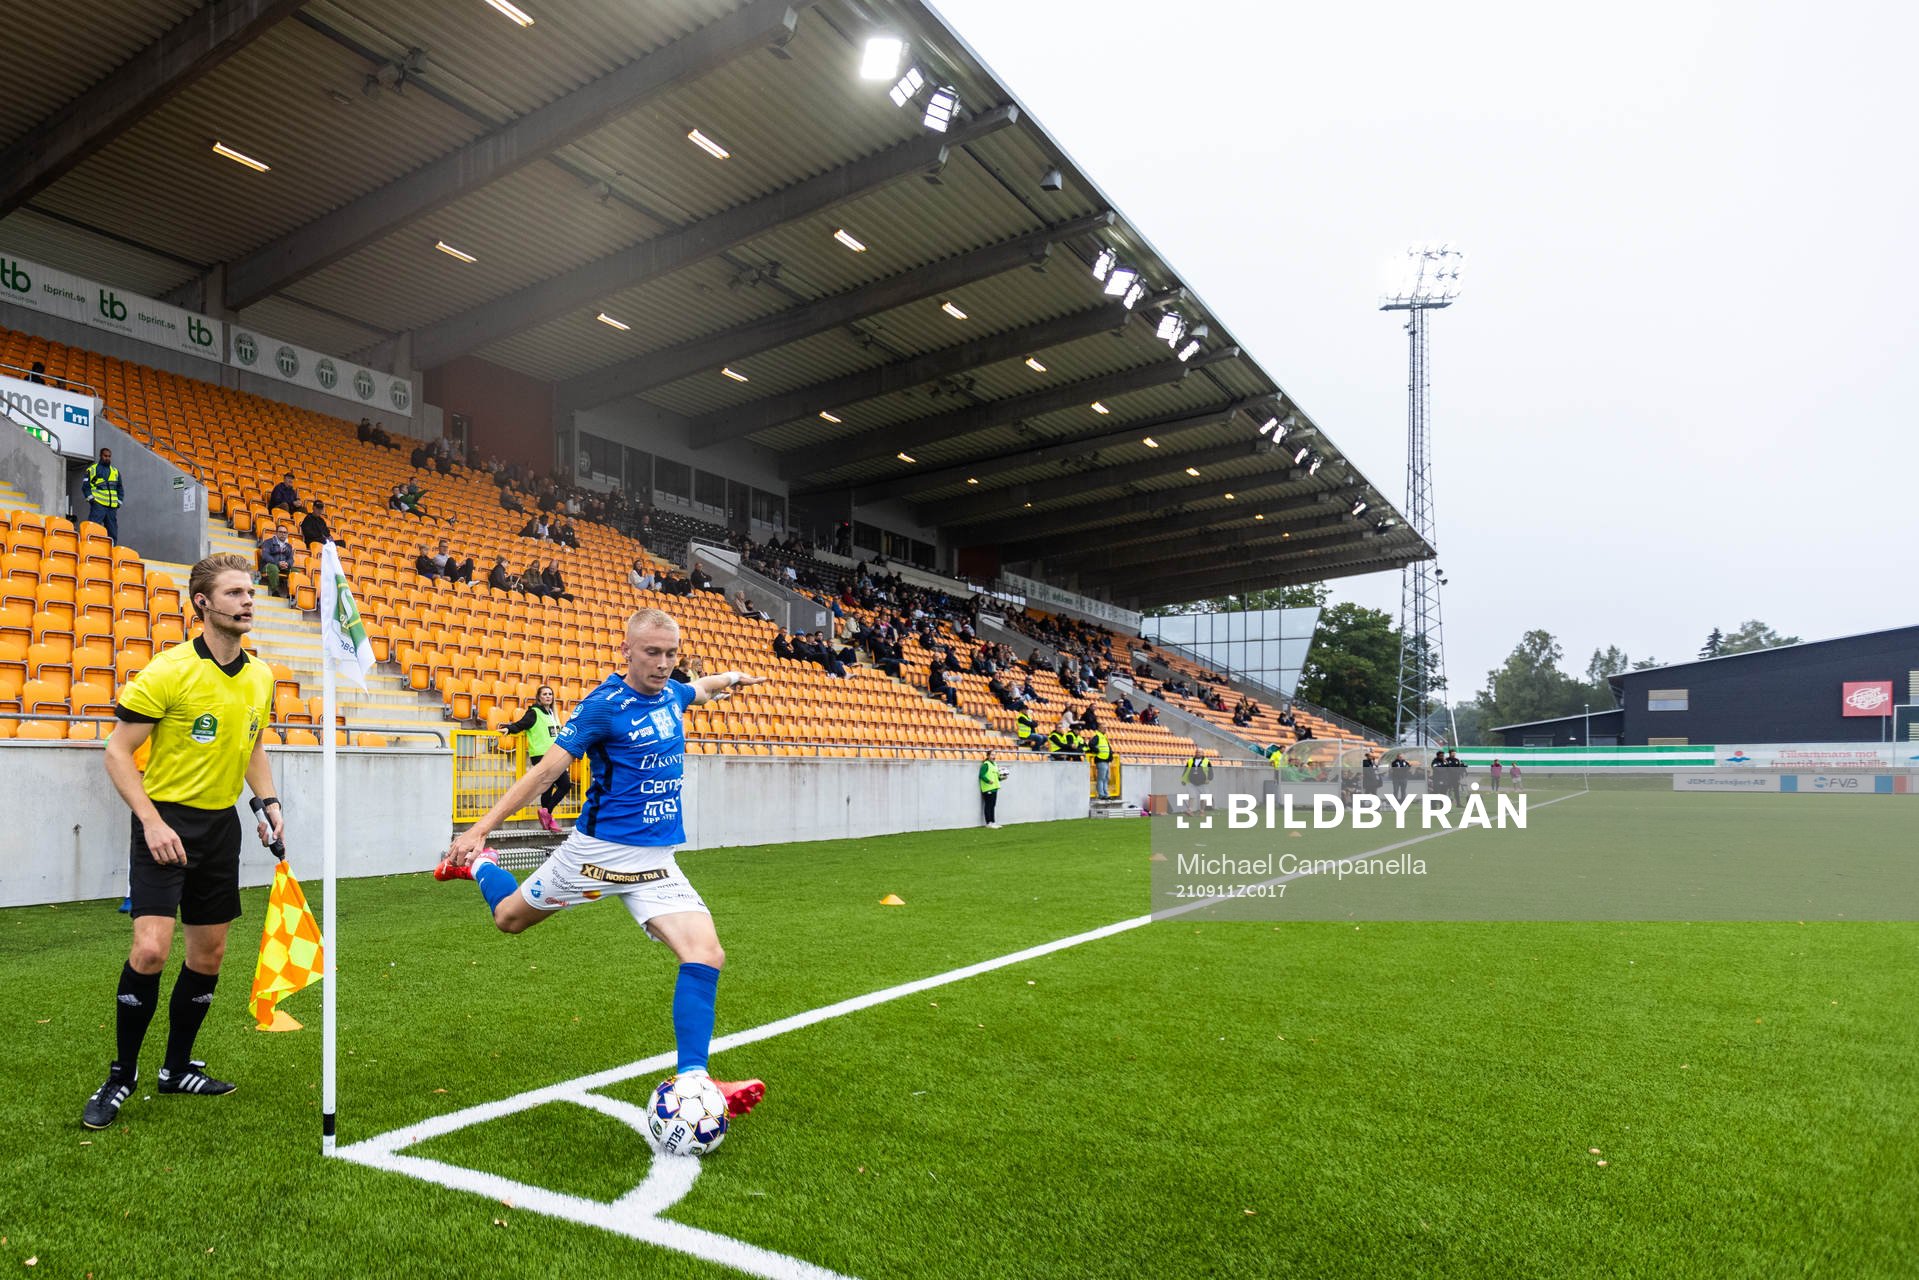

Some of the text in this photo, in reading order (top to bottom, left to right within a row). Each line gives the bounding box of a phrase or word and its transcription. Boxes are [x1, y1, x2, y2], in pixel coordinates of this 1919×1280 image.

[1, 258, 31, 293] tb
[43, 283, 86, 304] tbprint.se
[99, 289, 127, 321] tb
[138, 312, 176, 330] tbprint.se
[188, 316, 213, 347] tb
[0, 389, 61, 419] mer
[1829, 778, 1858, 788] FVB
[606, 872, 641, 882] NORRBY
